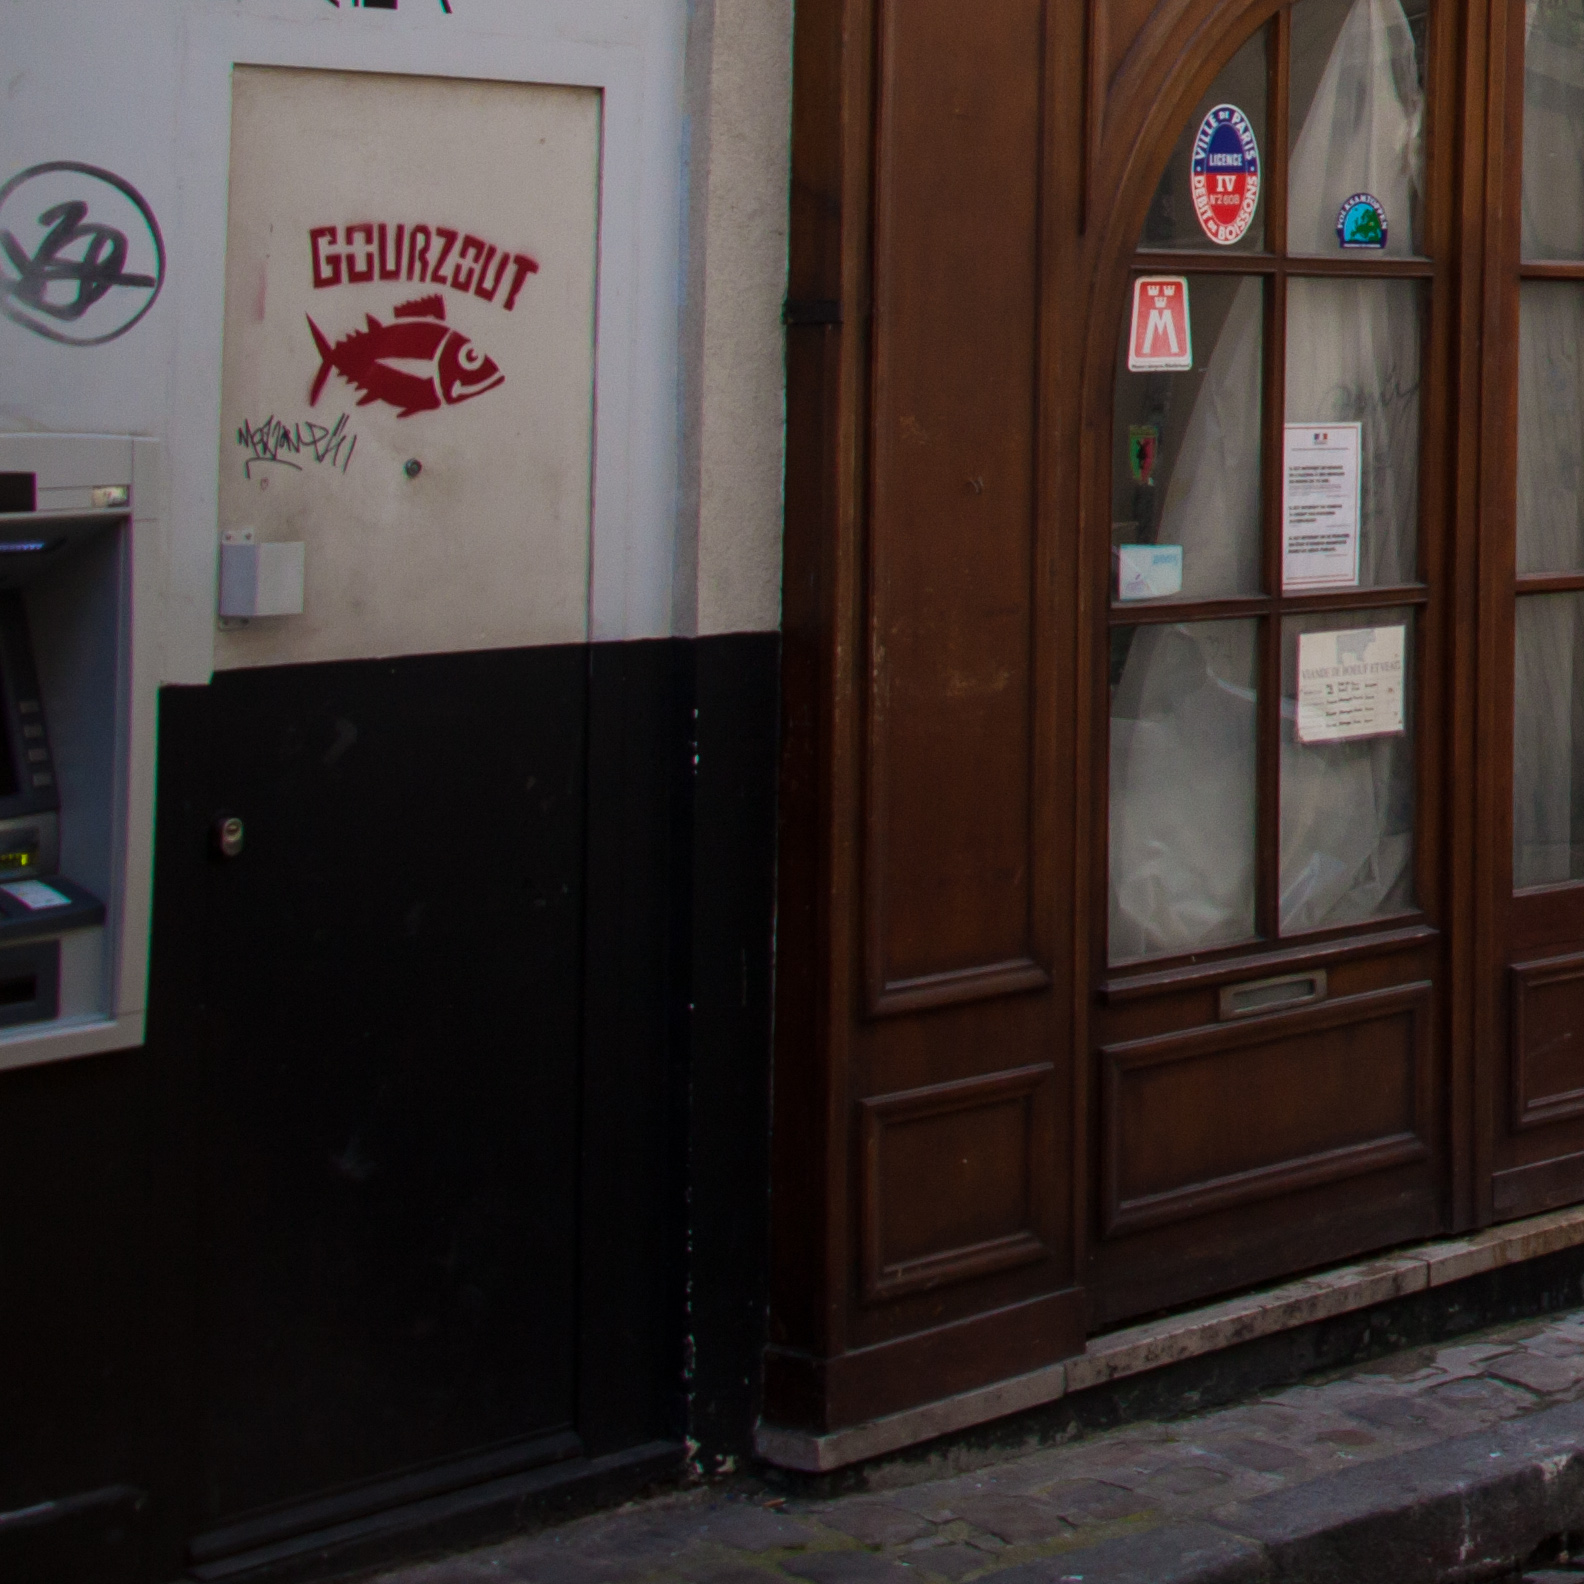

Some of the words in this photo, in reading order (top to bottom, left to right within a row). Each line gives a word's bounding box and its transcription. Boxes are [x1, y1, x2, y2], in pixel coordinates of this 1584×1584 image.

[1194, 114, 1219, 160] VILLE
[1231, 110, 1257, 161] PARIS
[1209, 153, 1243, 167] LICENCE
[1193, 175, 1213, 221] DEBIT
[1217, 175, 1258, 241] BOISSONS
[1216, 174, 1237, 193] IV
[308, 221, 540, 312] GOURZOUT
